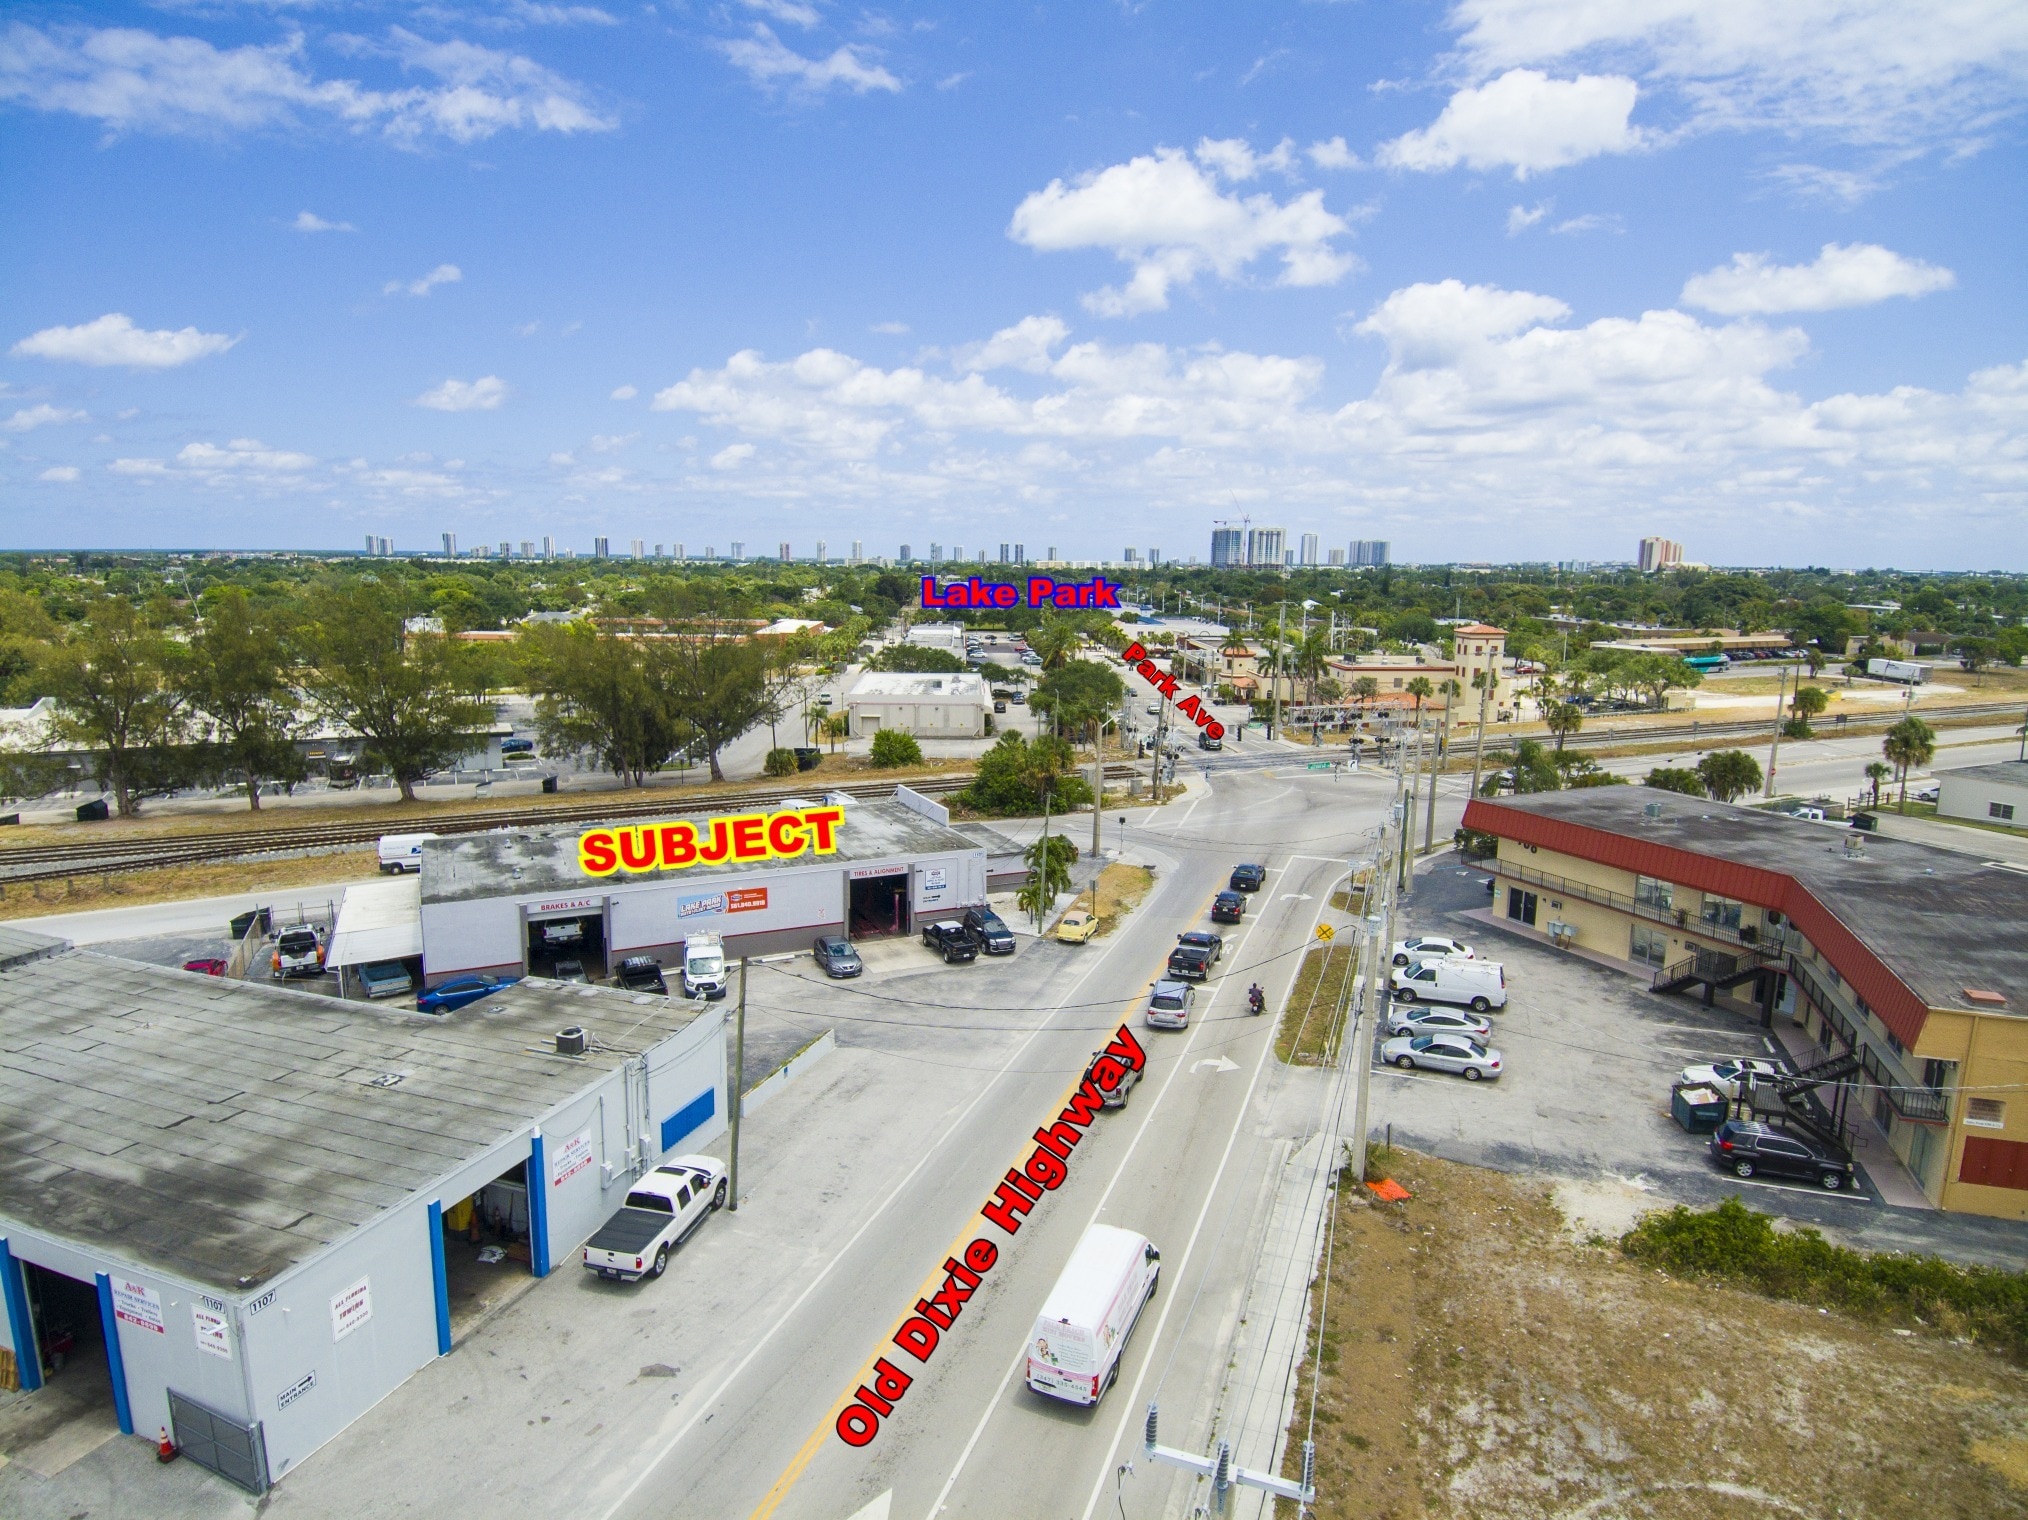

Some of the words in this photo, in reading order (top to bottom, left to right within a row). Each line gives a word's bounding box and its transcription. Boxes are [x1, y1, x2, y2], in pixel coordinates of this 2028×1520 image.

[874, 866, 904, 875] ALIGNMENT
[541, 902, 568, 910] BRAKES
[681, 901, 700, 912] LAKE
[702, 895, 722, 908] PARK
[125, 1282, 145, 1296] A&K
[205, 1298, 222, 1311] 1107
[253, 1293, 273, 1311] 1107
[334, 1299, 344, 1310] ALL
[345, 1286, 367, 1302] FLORIDA
[340, 1299, 364, 1320] TOWING
[280, 1387, 296, 1401] MAIN
[281, 1381, 314, 1408] ENTRANCE
